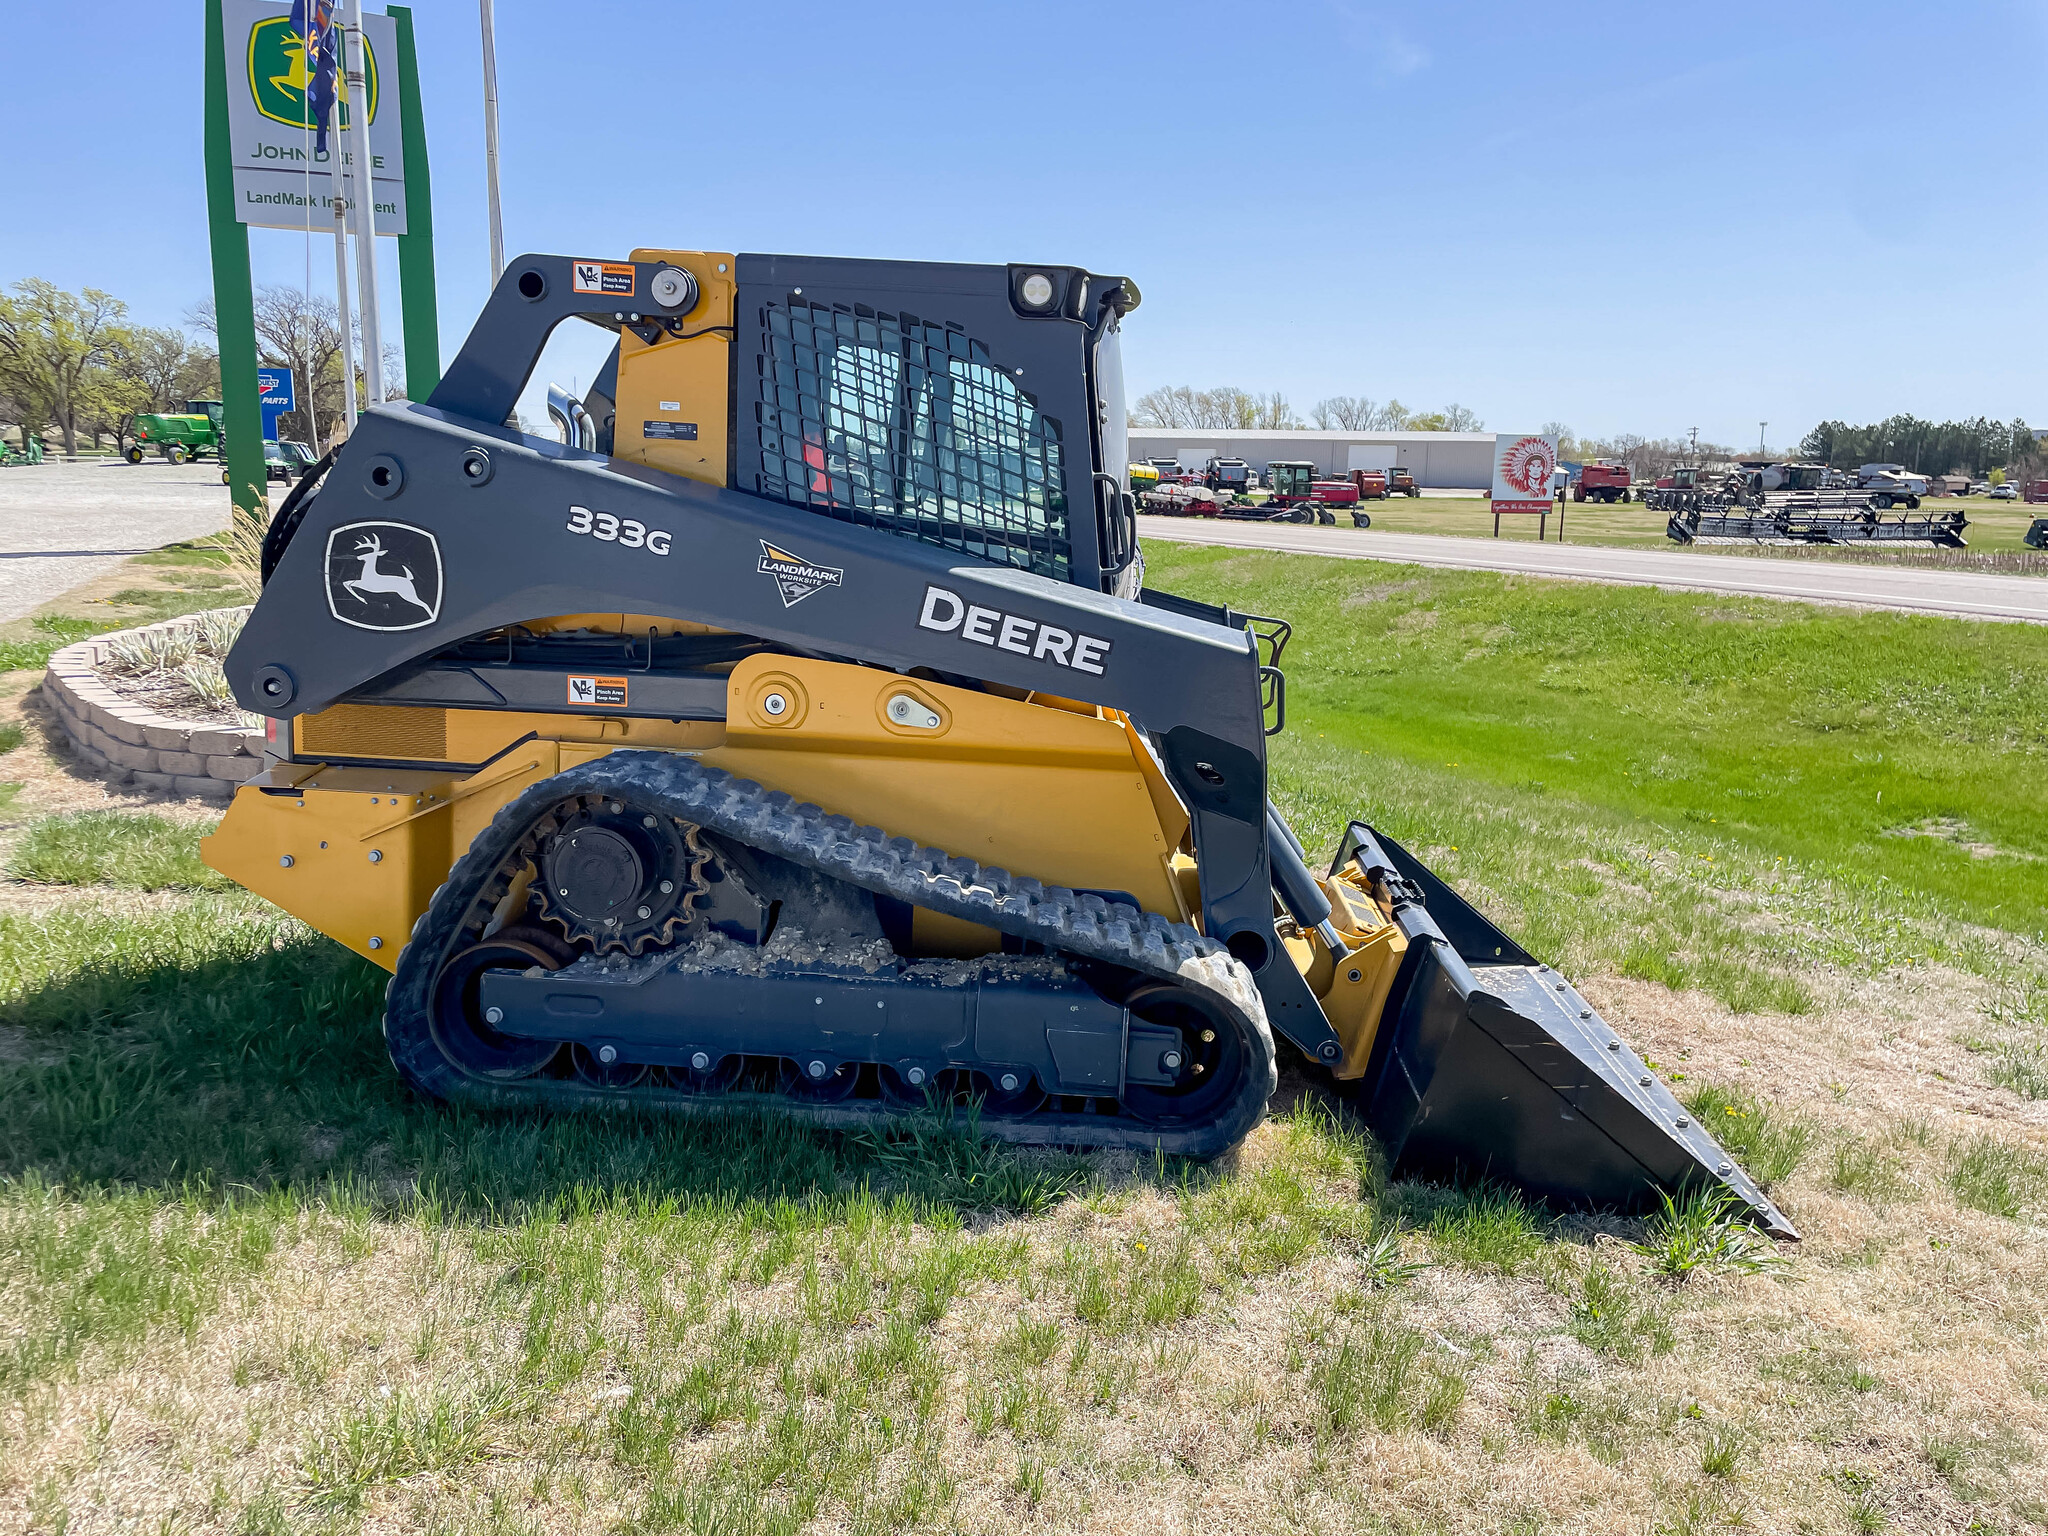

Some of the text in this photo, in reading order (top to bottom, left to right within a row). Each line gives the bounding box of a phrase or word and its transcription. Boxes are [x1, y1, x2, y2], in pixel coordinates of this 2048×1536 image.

[246, 190, 317, 208] LandMark
[566, 506, 672, 556] 333G
[779, 572, 823, 586] WORKSITE
[918, 585, 1111, 676] DEERE
